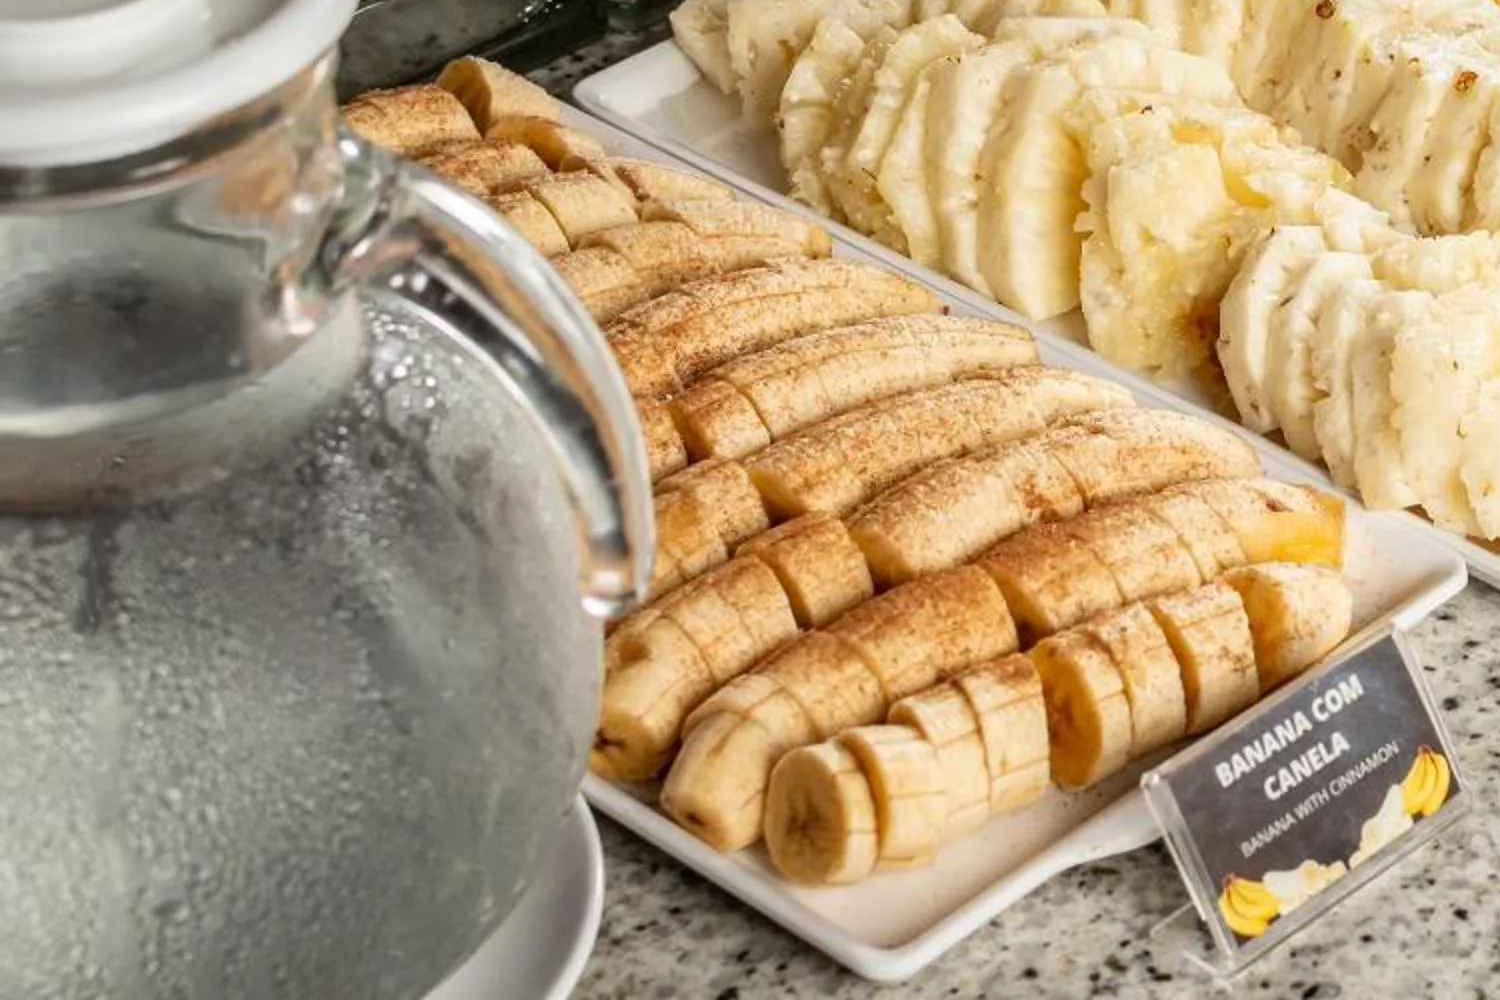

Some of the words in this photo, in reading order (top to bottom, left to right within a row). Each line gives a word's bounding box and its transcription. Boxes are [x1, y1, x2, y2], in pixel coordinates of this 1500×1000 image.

[1214, 710, 1313, 788] BANANA
[1311, 673, 1365, 723] COM
[1263, 731, 1351, 801] CANELA
[1240, 813, 1297, 858] BANANA
[1292, 788, 1330, 821] WITH
[1328, 740, 1401, 797] CINNAMON
